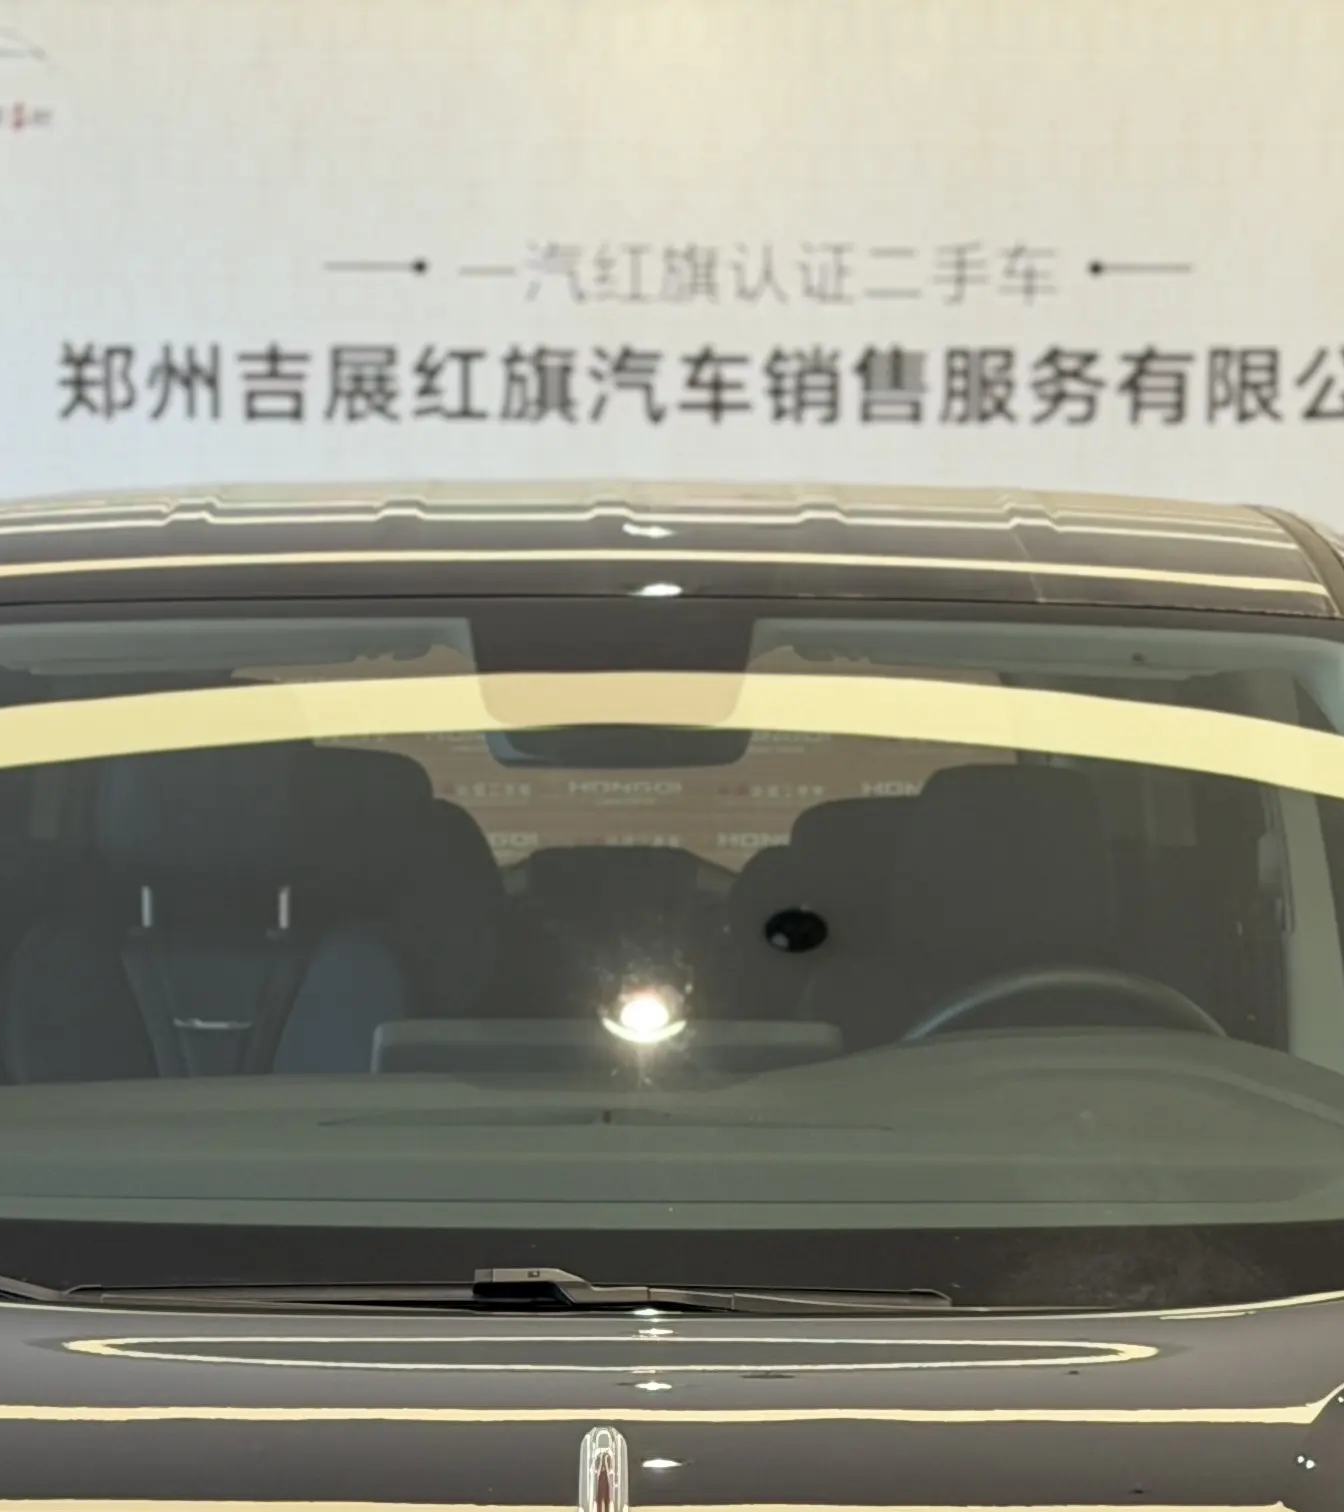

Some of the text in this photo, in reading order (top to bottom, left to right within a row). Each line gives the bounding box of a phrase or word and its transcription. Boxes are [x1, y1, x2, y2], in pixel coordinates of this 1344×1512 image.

[459, 241, 1058, 305] 一汽红旗认证二手车
